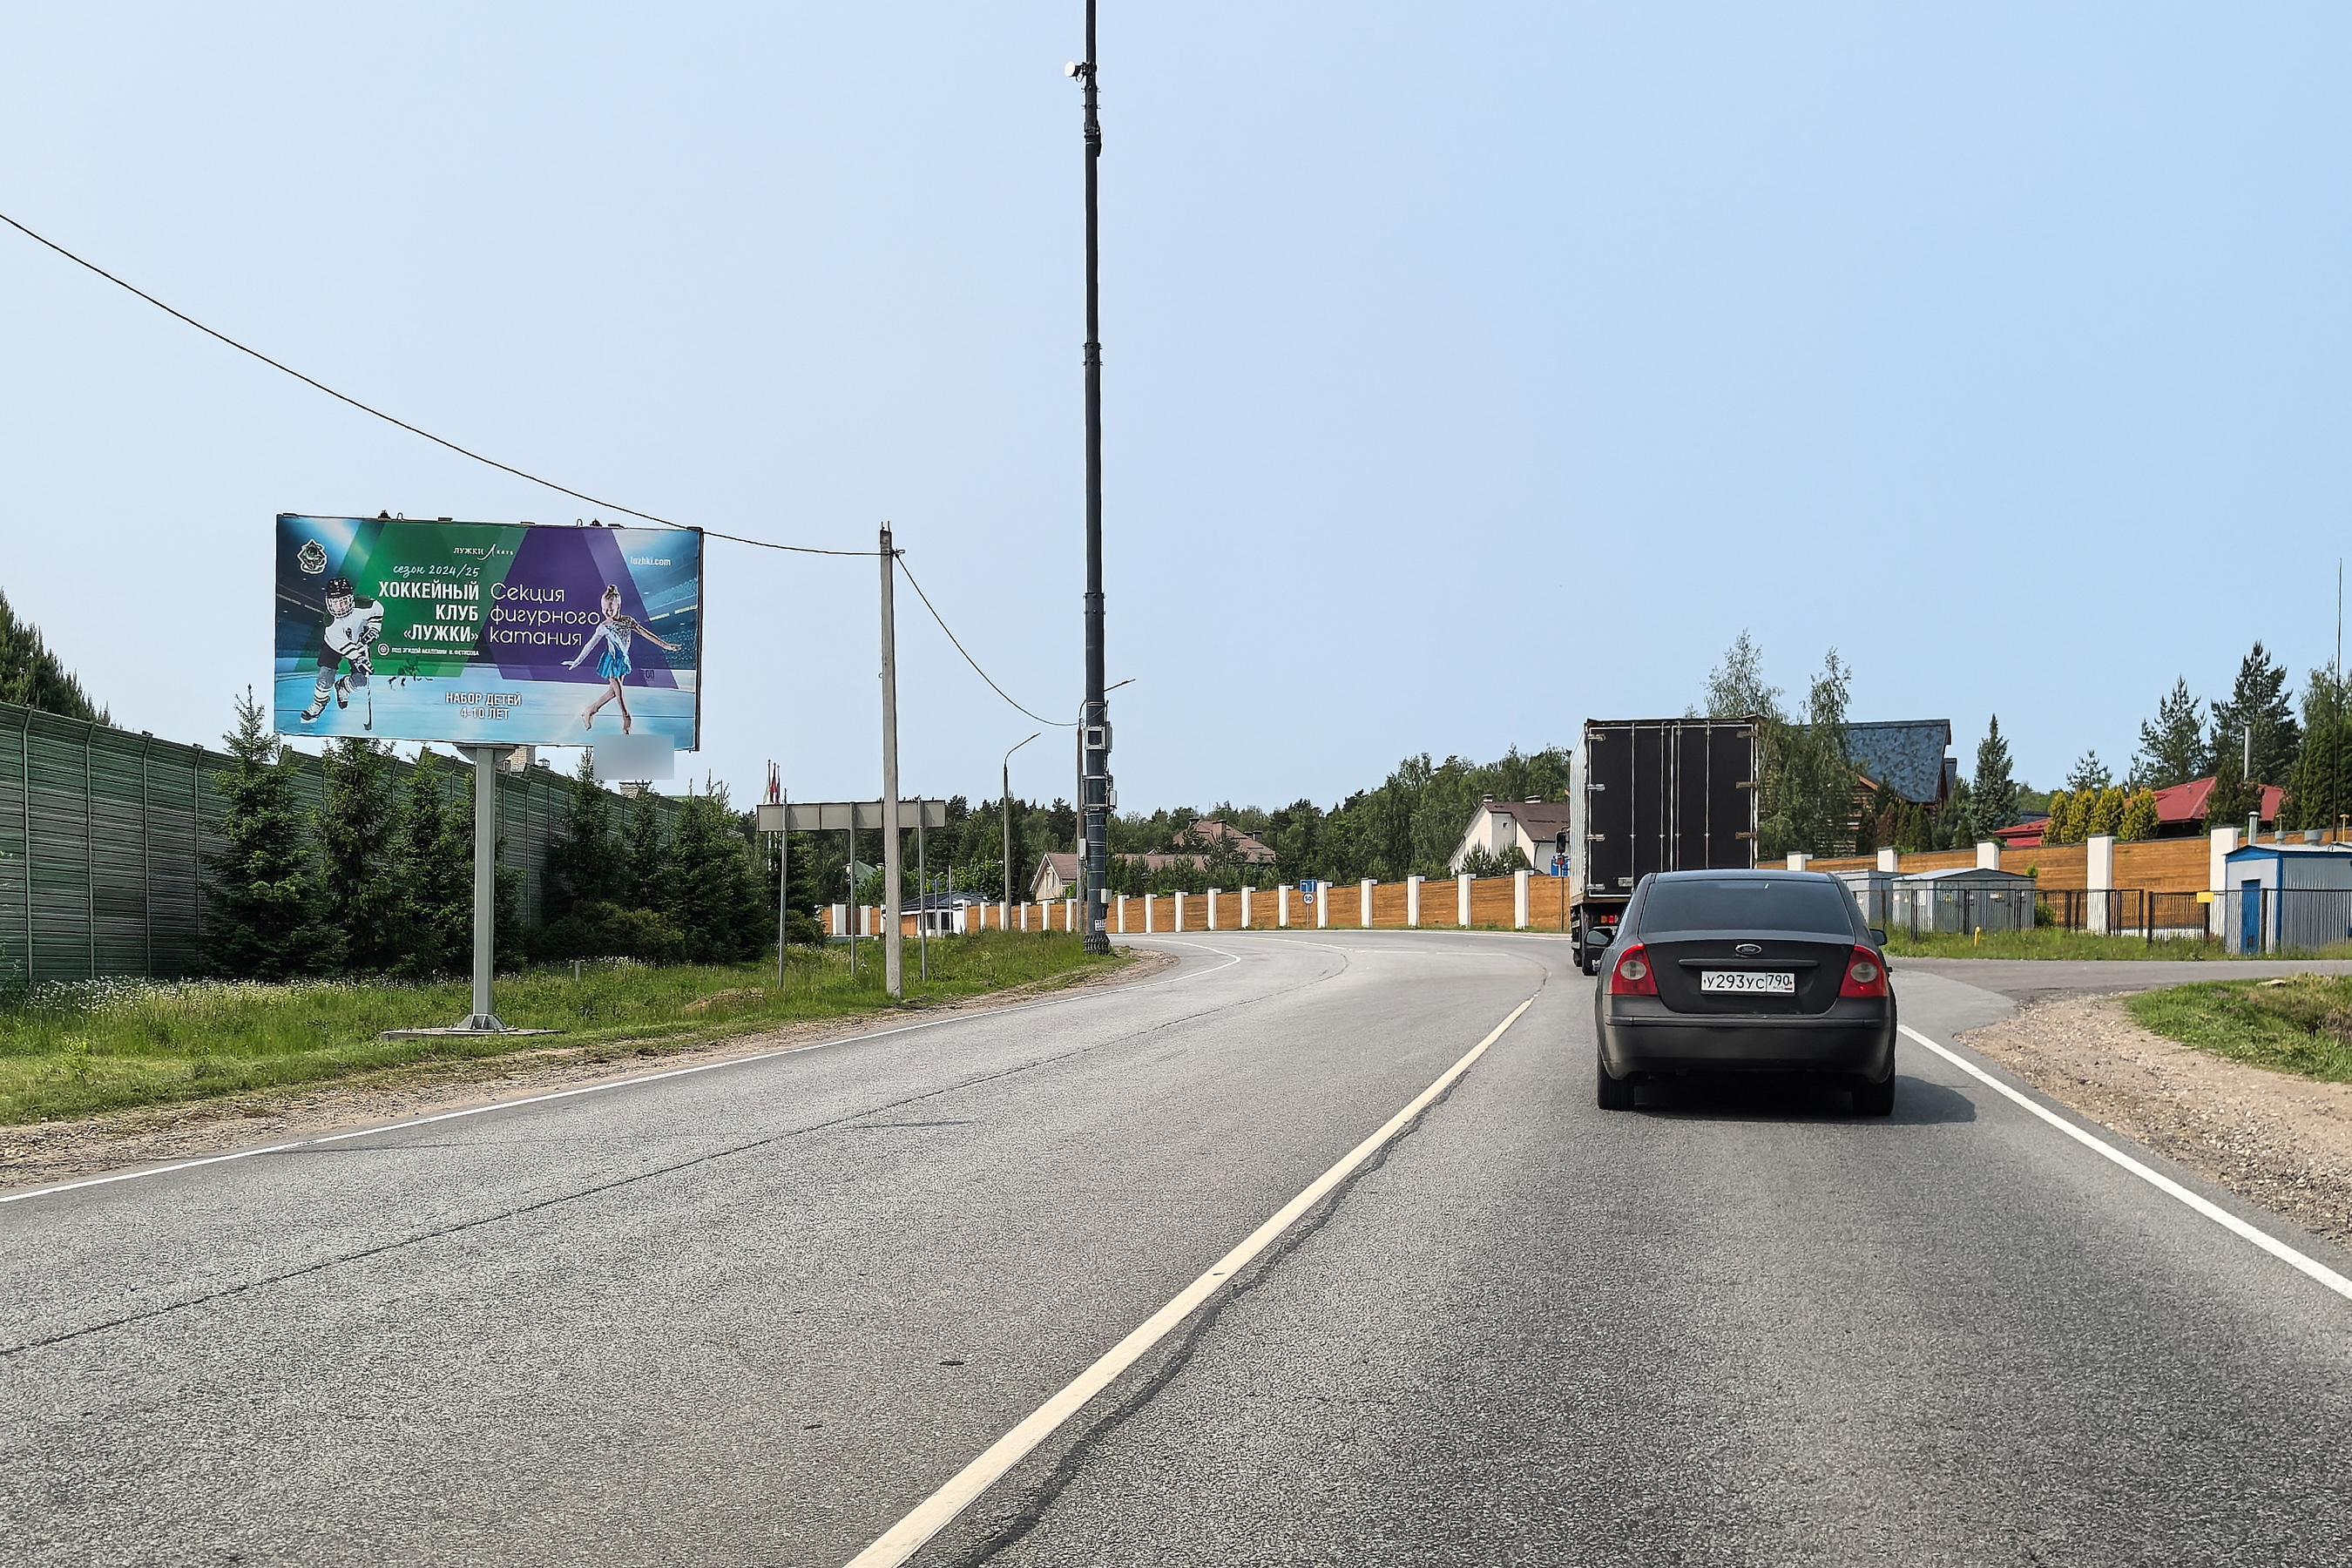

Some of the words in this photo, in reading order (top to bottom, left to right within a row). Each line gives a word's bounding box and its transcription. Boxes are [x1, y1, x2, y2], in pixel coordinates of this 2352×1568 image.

[453, 547, 484, 556] ЛУЖКИ
[393, 565, 425, 578] сезон
[429, 564, 480, 578] 2024/25
[378, 578, 479, 601] ХОККЕЙНЫЙ
[490, 582, 565, 605] Секция
[436, 604, 479, 622] КЛУБ
[490, 605, 601, 627] фигурного
[403, 624, 479, 643] «ЛУЖКИ»
[490, 625, 582, 646] катания
[445, 692, 483, 705] НАБОР
[485, 692, 522, 707] ДЕТЕЙ
[461, 706, 485, 719] 4-10
[488, 707, 510, 720] ЛЕТ
